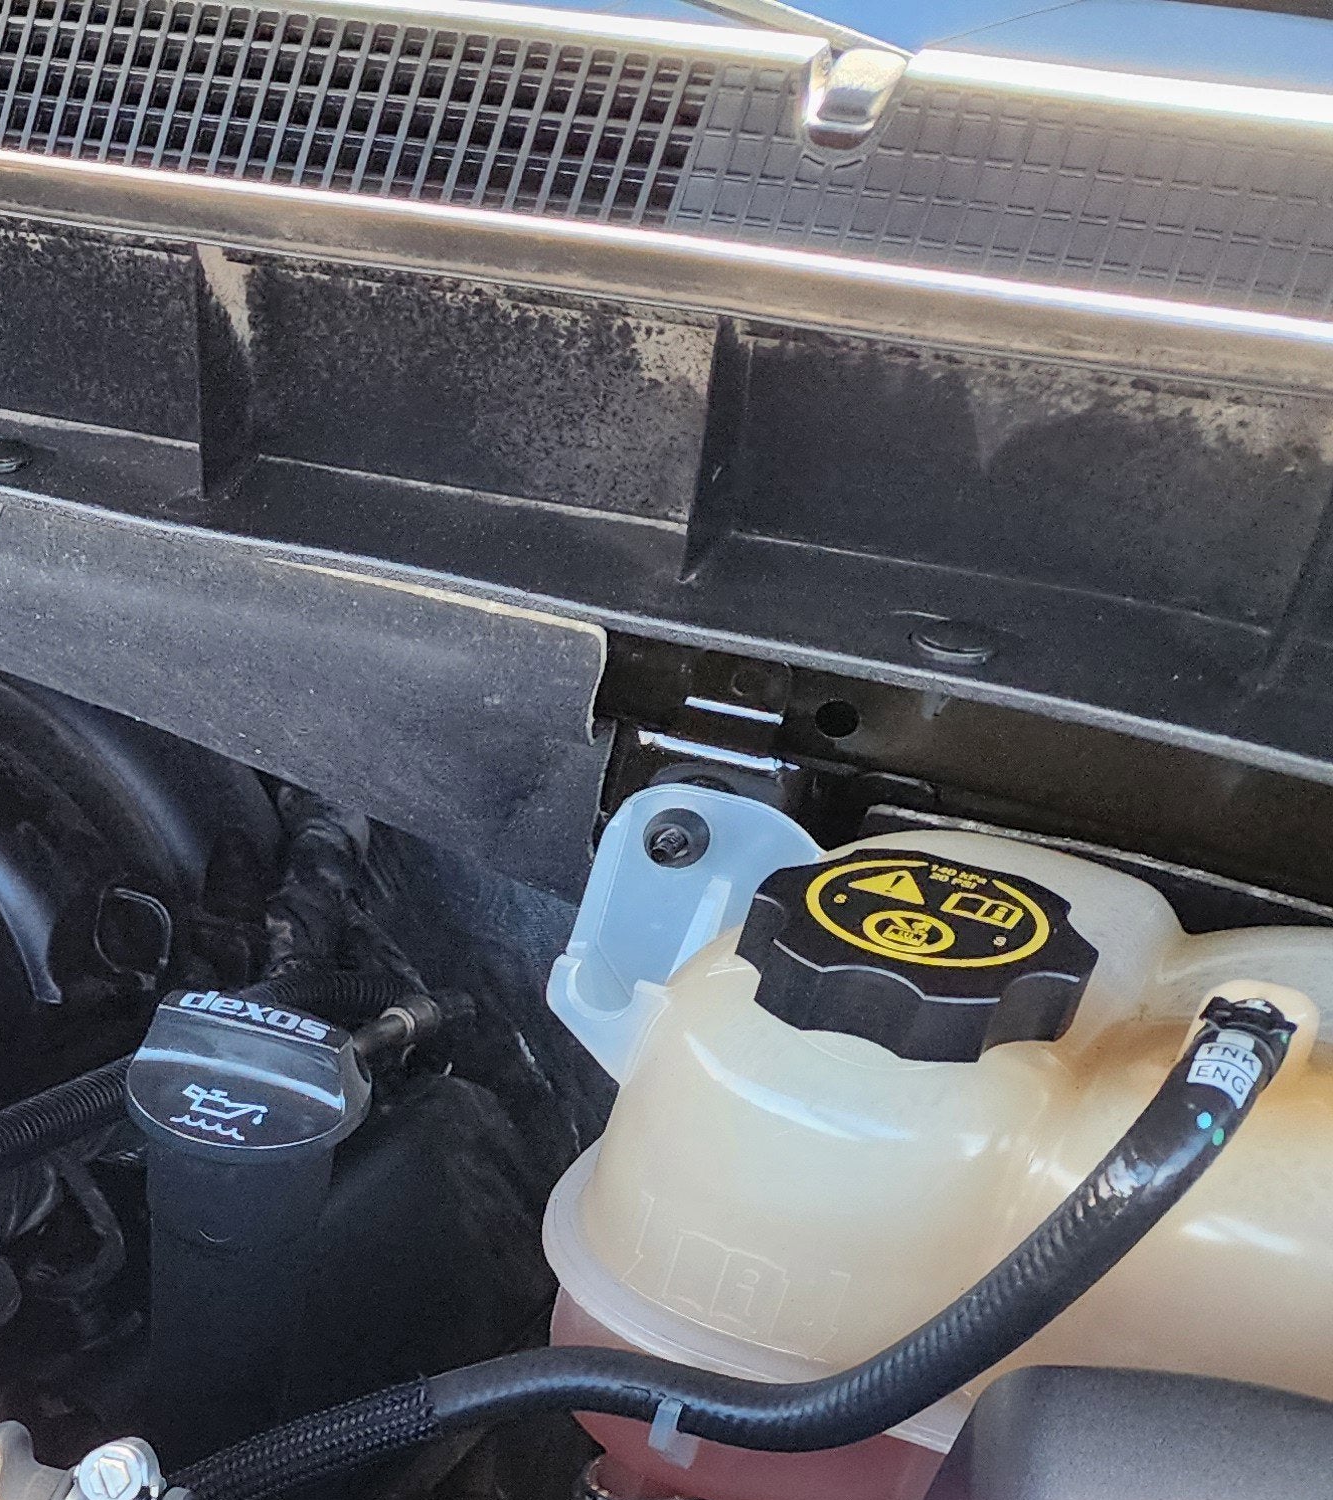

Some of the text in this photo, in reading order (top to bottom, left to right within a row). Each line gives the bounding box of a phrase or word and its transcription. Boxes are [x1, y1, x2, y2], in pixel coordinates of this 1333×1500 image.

[951, 878, 978, 890] PSI
[179, 991, 331, 1041] dexos
[1206, 1046, 1256, 1072] TNK
[1195, 1065, 1247, 1095] ENG
